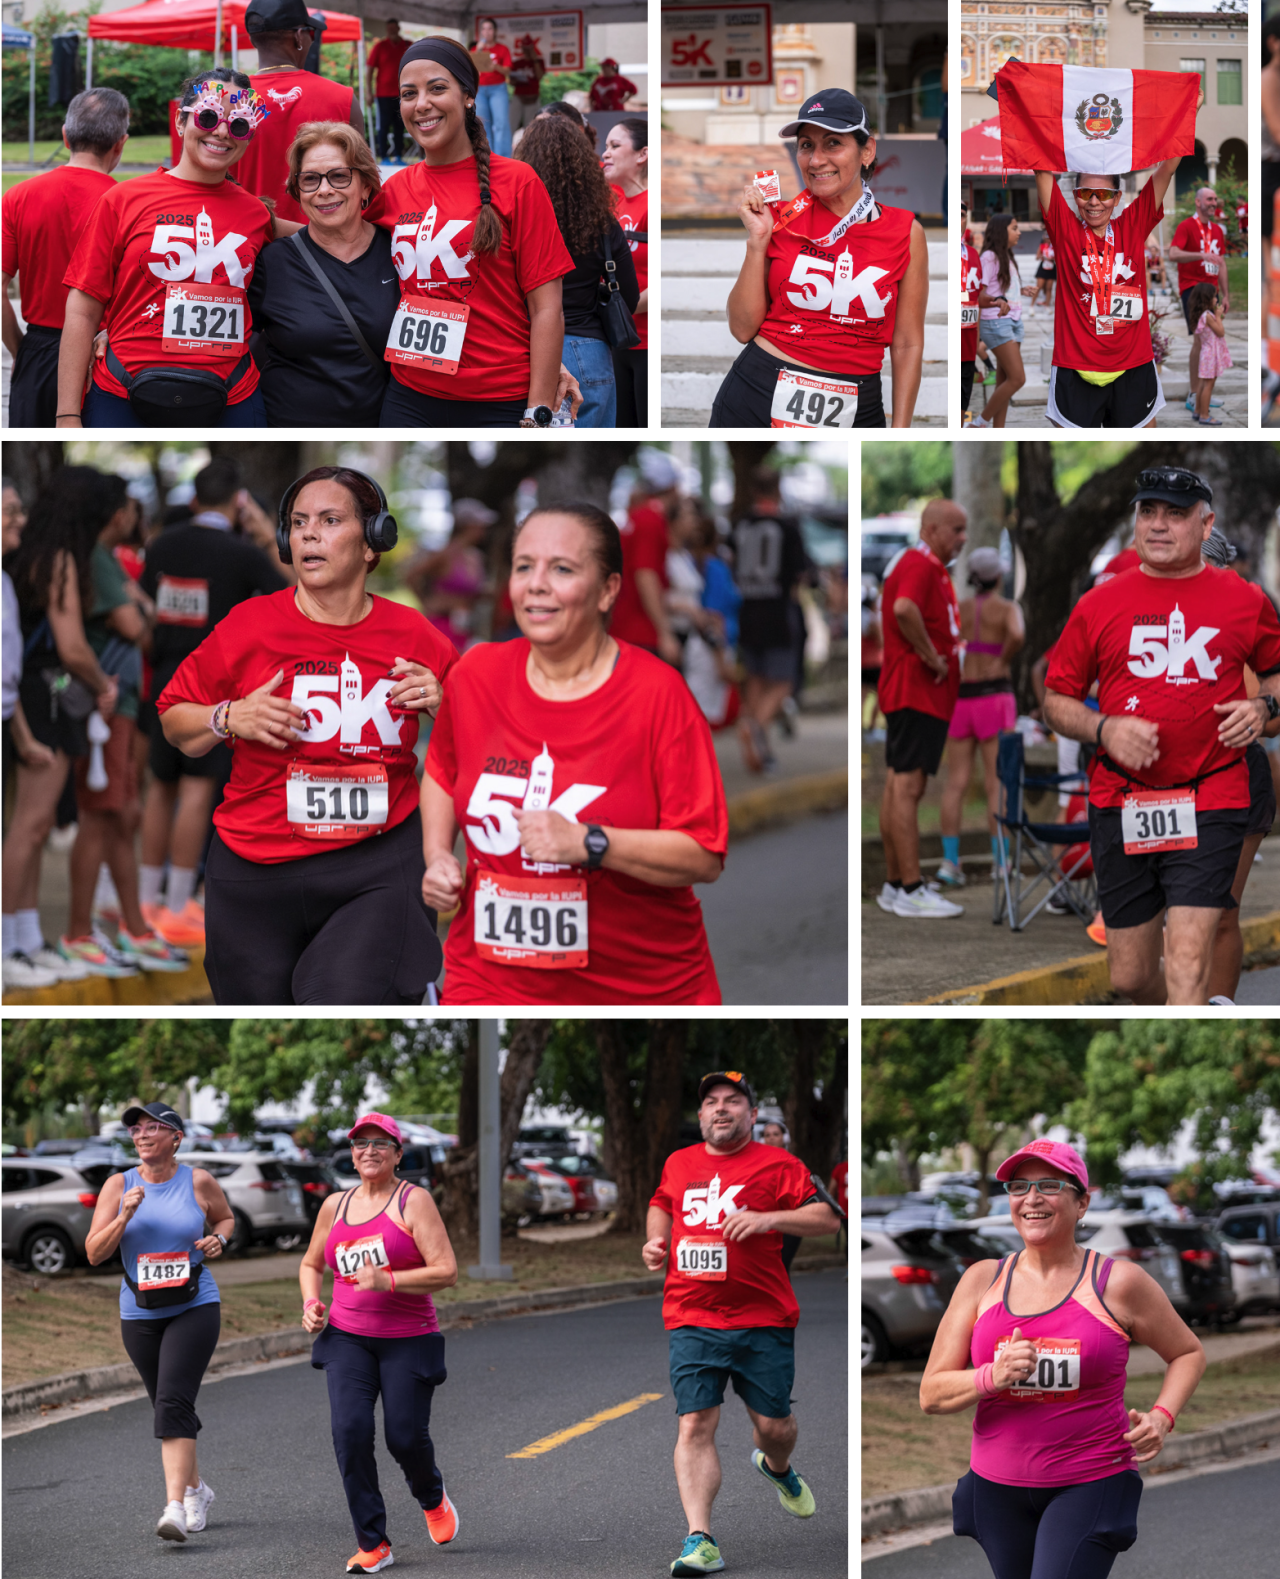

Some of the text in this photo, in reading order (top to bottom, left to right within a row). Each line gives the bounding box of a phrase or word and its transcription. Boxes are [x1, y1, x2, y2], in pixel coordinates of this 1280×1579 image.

[671, 33, 714, 67] 5K
[193, 81, 271, 119] HAPPY BIRTHDAY
[793, 198, 809, 212] 5K
[156, 214, 194, 226] 2025
[395, 212, 424, 225] 2025
[148, 205, 248, 289] 5K
[390, 195, 473, 281] 5K
[800, 244, 835, 263] 2025
[169, 286, 188, 301] 5K
[189, 293, 213, 301] Vamos
[786, 244, 891, 319] 5K
[172, 304, 239, 339] 1321
[409, 305, 429, 316] Vamos
[430, 309, 441, 318] por
[441, 310, 448, 319] la
[1111, 298, 1133, 319] 21
[398, 316, 449, 355] 696
[799, 378, 823, 389] Vamos
[786, 389, 844, 428] 492
[1133, 614, 1167, 625] 2025
[1127, 602, 1222, 680] 5K
[294, 660, 339, 675] 2025
[291, 651, 404, 745] 5K
[312, 775, 340, 783] Vamos
[484, 756, 530, 777] 2025
[306, 786, 369, 820] 510
[1135, 808, 1182, 838] 301
[479, 877, 499, 897] 5K
[499, 888, 530, 900] Vamos
[532, 891, 548, 901] por
[551, 891, 560, 901] la
[484, 901, 578, 947] 1496
[682, 1172, 748, 1227] 5K
[142, 1264, 186, 1281] 1487
[340, 1247, 384, 1275] 1201
[680, 1249, 723, 1270] 1095
